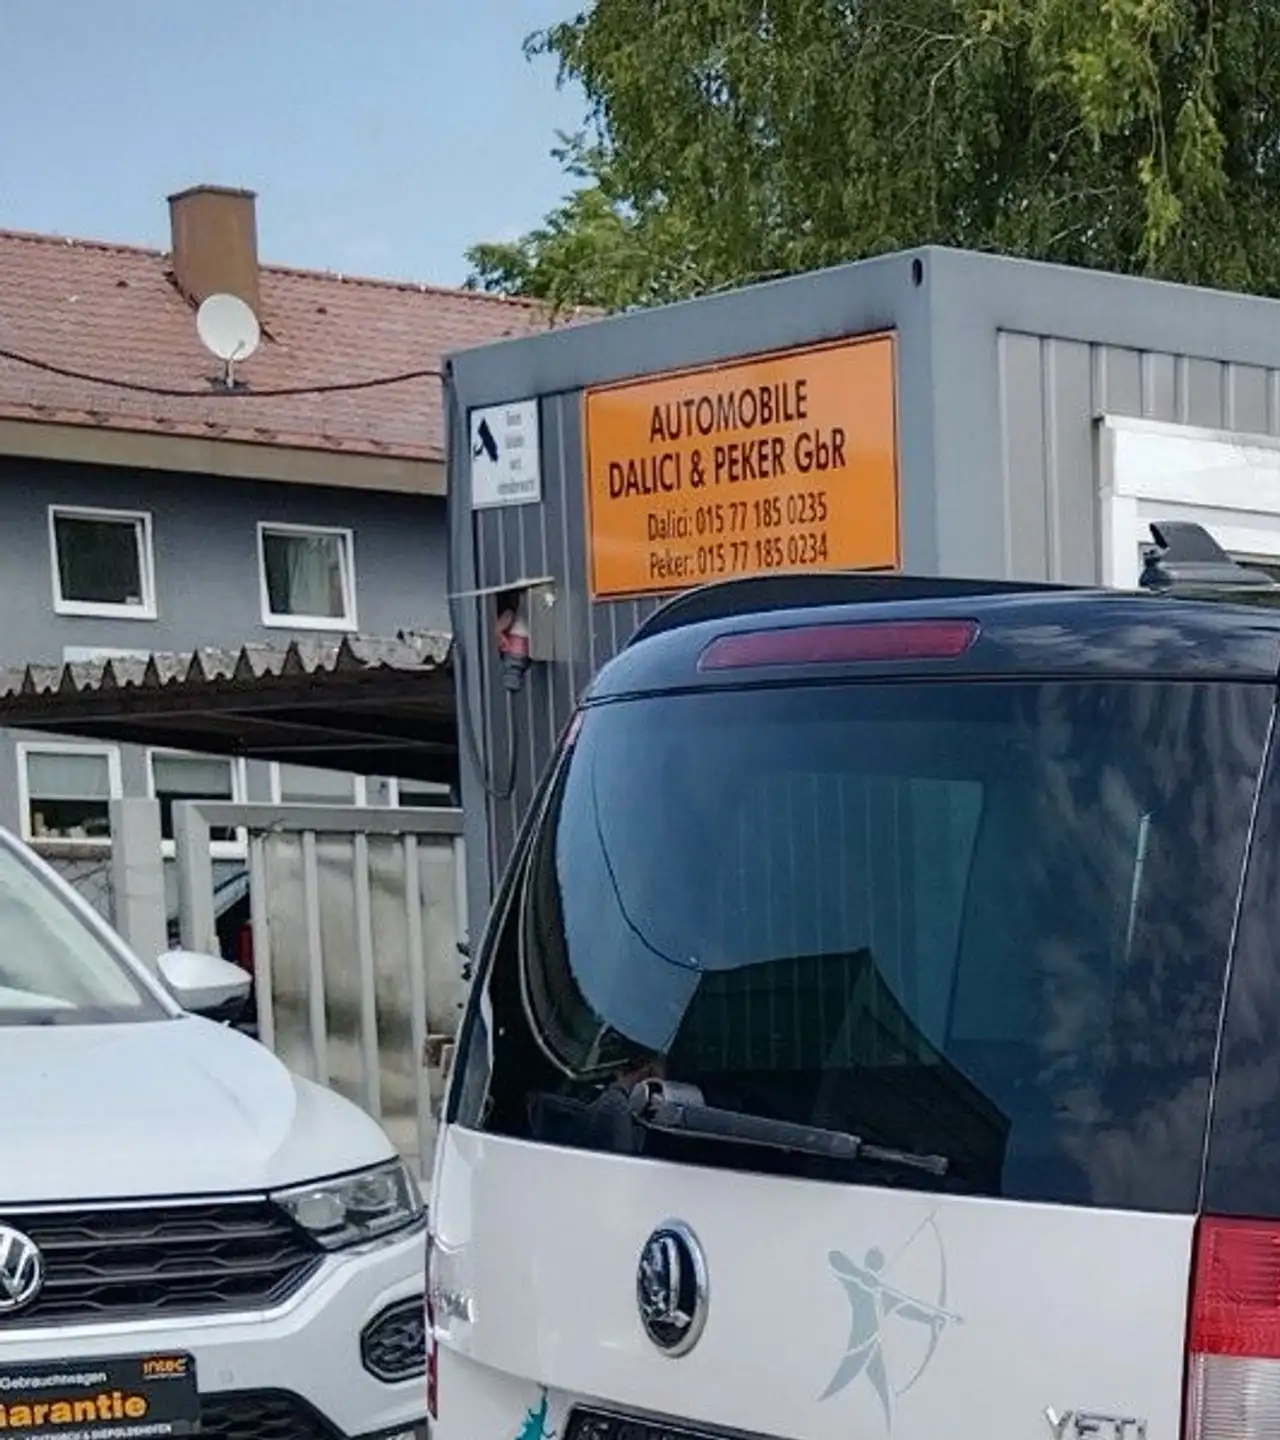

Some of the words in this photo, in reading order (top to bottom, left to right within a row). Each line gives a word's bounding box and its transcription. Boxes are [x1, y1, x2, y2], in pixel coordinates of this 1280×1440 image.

[650, 379, 808, 443] AUTOMOBILE
[609, 451, 682, 499] DALICI
[690, 449, 706, 489] &
[713, 436, 786, 485] PEKER
[794, 427, 846, 473] GbR
[647, 508, 693, 542] Dalici:
[695, 503, 724, 536] 015
[729, 501, 748, 532] 77
[753, 496, 782, 528] 185
[787, 491, 828, 525] 0235
[649, 549, 695, 580] Peker:
[697, 542, 726, 575] 015
[729, 540, 749, 572] 77
[755, 536, 784, 568] 185
[787, 531, 828, 565] 0234
